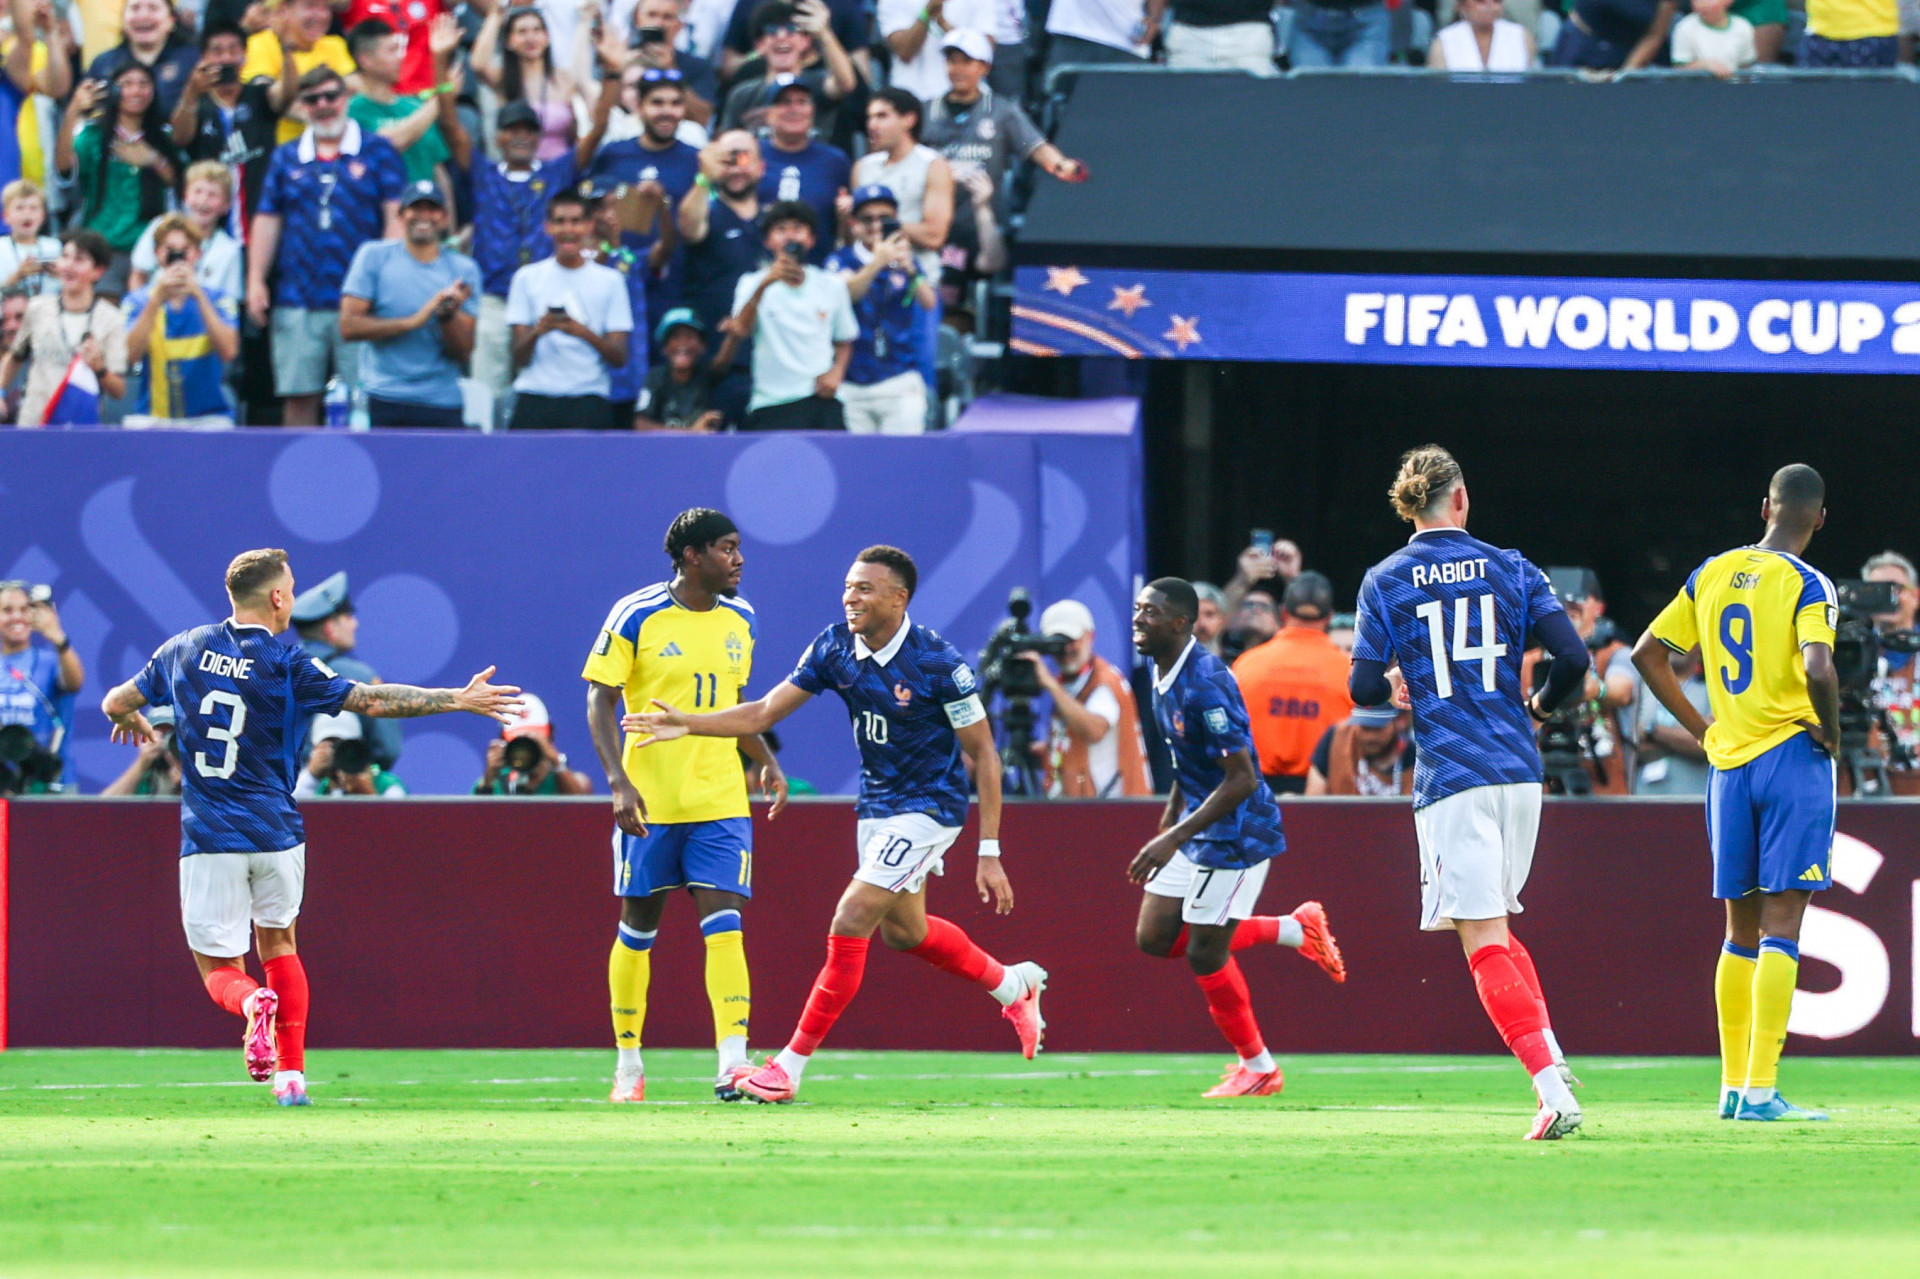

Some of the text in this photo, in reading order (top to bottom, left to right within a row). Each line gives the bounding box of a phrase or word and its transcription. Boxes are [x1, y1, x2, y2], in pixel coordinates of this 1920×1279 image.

[1345, 293, 1487, 347] FIFA
[1494, 295, 1740, 352] WORLD
[1747, 300, 1885, 354] CUP
[1411, 558, 1489, 588] RABIOT
[1415, 593, 1508, 699] 14
[1719, 602, 1753, 695] 9
[199, 650, 255, 680] DIGNE
[694, 672, 717, 708] 11
[194, 689, 248, 780] 3
[862, 710, 889, 745] 10
[876, 834, 912, 867] 10
[1196, 869, 1214, 899] 7
[1786, 831, 1920, 1040] S
